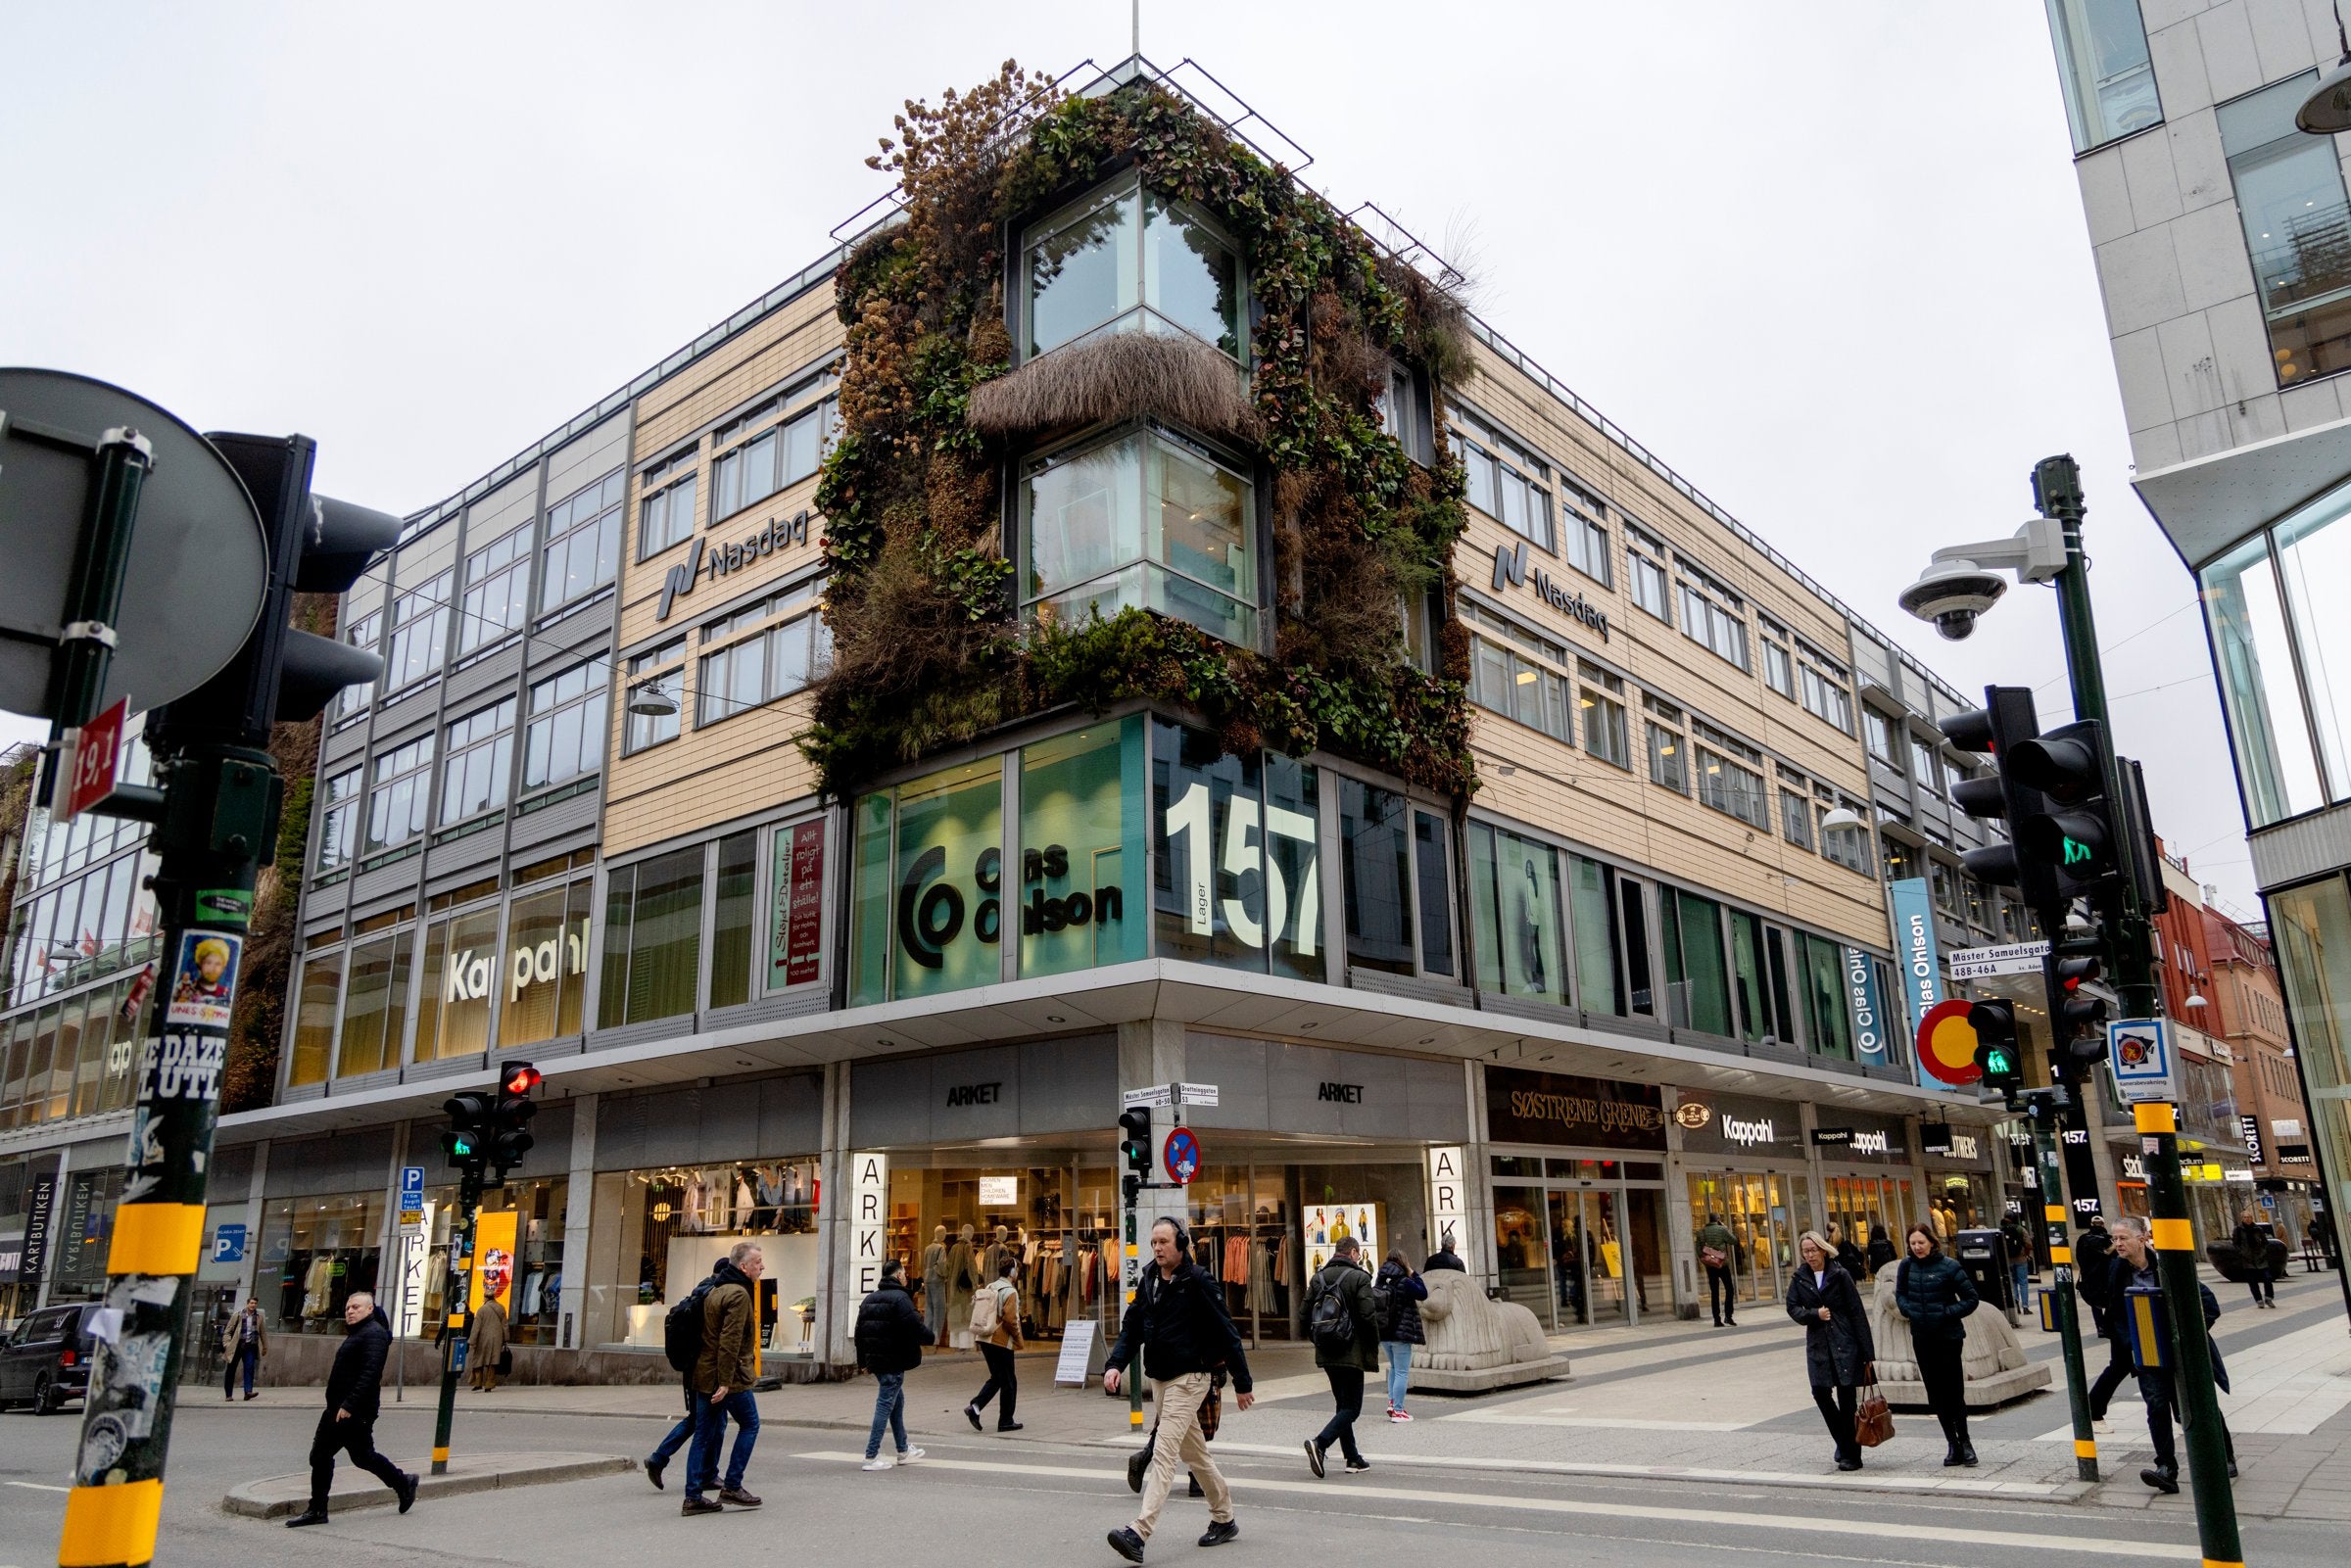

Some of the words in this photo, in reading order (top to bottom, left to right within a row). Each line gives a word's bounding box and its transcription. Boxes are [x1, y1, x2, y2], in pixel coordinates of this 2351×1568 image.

[708, 509, 808, 581] Nasdaq
[1534, 567, 1609, 643] Nasdaq
[800, 830, 817, 843] Allt
[795, 844, 821, 861] roligt
[801, 859, 814, 879] på
[1166, 783, 1319, 956] 157
[798, 877, 815, 890] ett
[792, 892, 819, 910] ställe!
[1197, 882, 1208, 926] Lager
[1910, 914, 1930, 977] Ohlson
[1952, 952, 1985, 963] Mäster
[1989, 945, 2050, 959] Samuelsgata
[1954, 964, 1997, 977] 48B-46A
[161, 1034, 226, 1069] DAZE
[946, 1082, 1002, 1107] ARKET
[1140, 1087, 1170, 1097] Samuelsgatan
[1181, 1085, 1217, 1094] Drottninggatan
[1318, 1082, 1364, 1104] ARKET
[1511, 1091, 1599, 1128] SØSTRENE
[1599, 1101, 1648, 1133] GRENE
[1721, 1115, 1774, 1147] Kappahl
[1818, 1131, 1848, 1141] Kappahl
[2061, 1129, 2088, 1144] 157.
[2241, 1117, 2262, 1163] SCORETT
[1849, 1130, 1888, 1155] appahl
[1943, 1134, 1978, 1160] OTHERS
[408, 1169, 421, 1190] P
[2073, 1198, 2099, 1212] 157.
[24, 1182, 52, 1274] KARTBUTIKEN
[860, 1159, 880, 1294] ARKE
[215, 1238, 232, 1258] P
